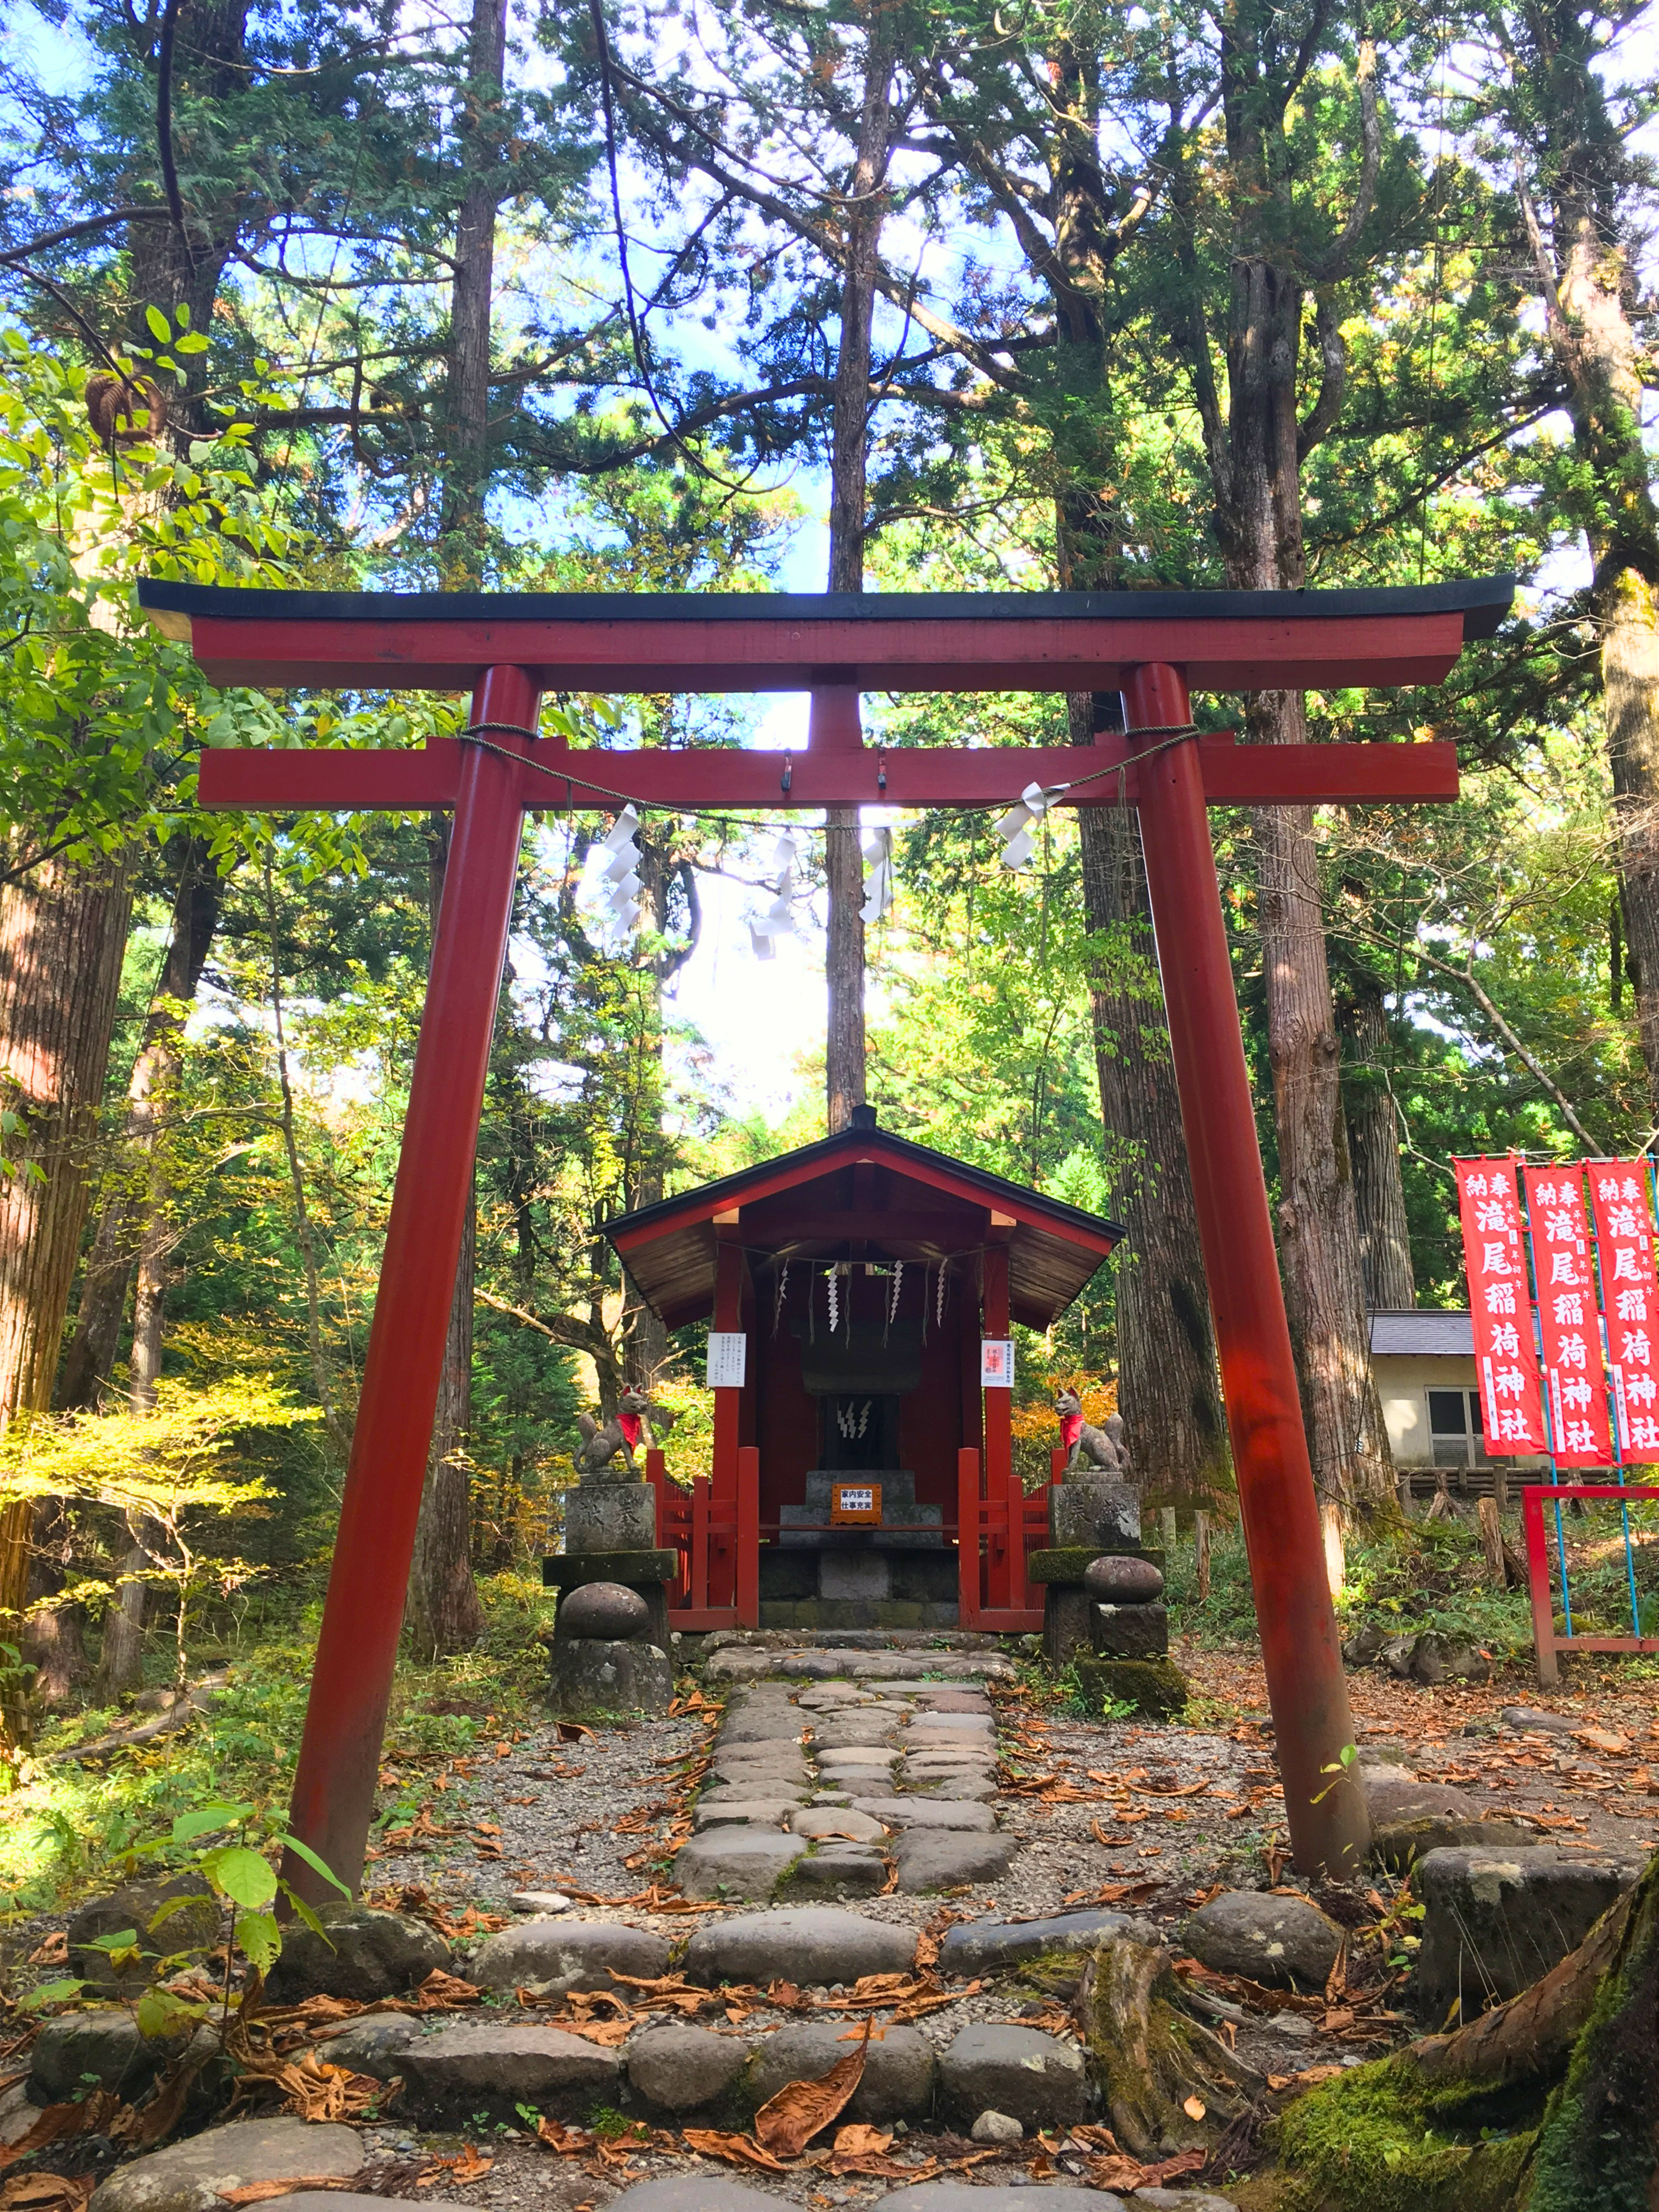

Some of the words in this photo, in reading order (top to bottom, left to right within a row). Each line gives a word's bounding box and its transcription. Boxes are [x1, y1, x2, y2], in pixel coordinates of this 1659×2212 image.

[1475, 1200, 1532, 1441] 滝尾稲荷神社
[1544, 1209, 1599, 1453] 滝尾稲荷神社
[1607, 1205, 1659, 1450] 滝尾稲荷神社
[842, 1501, 871, 1510] 仕事充実
